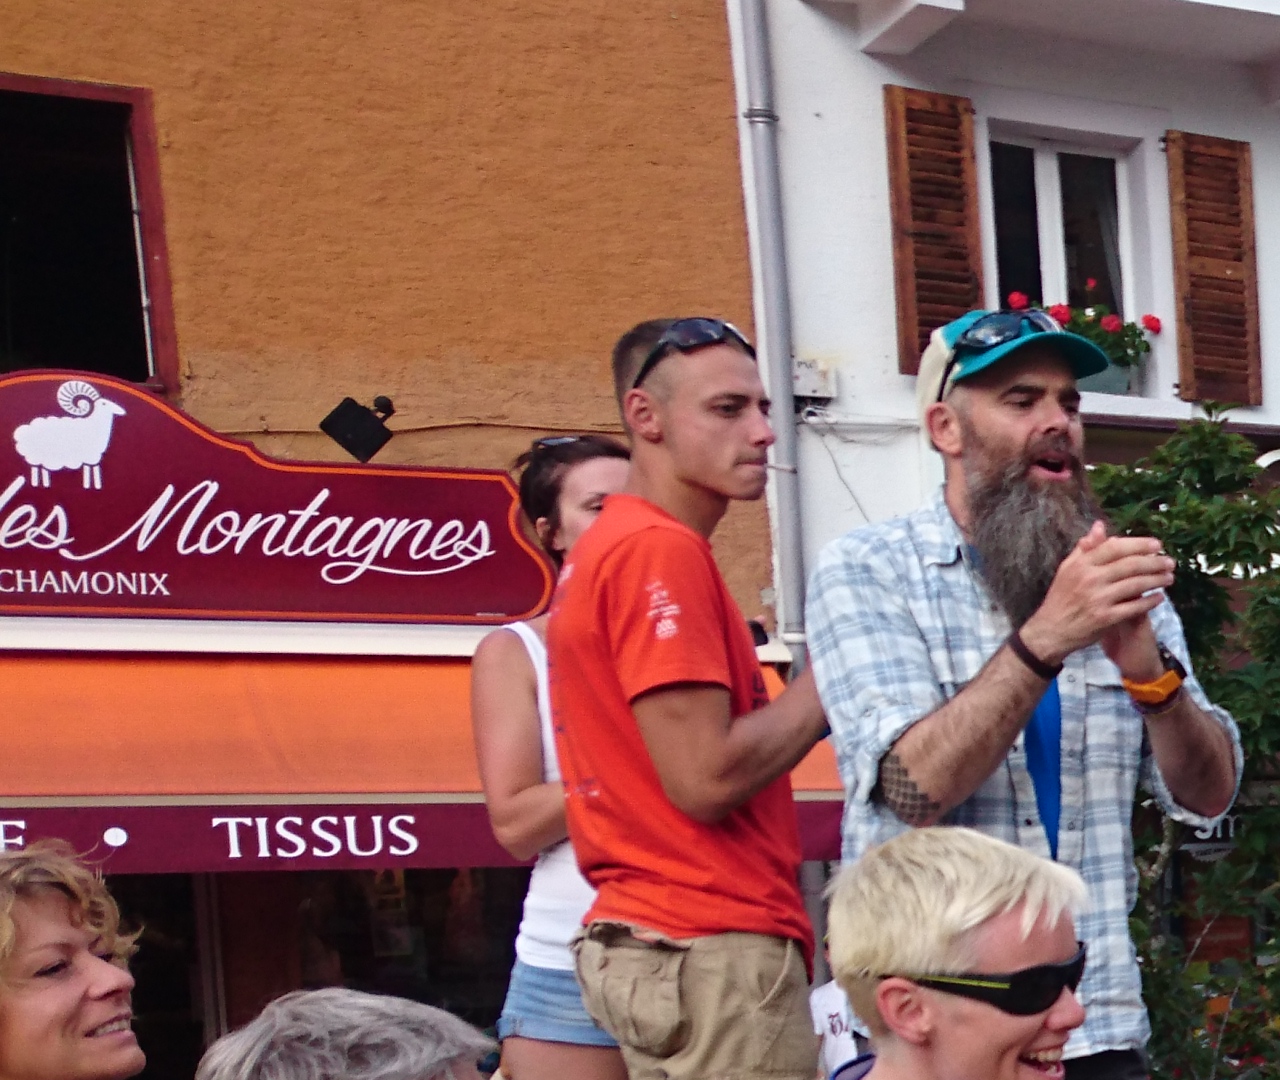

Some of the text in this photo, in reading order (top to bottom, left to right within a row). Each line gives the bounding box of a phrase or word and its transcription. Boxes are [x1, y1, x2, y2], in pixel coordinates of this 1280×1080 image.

[60, 480, 496, 584] Montagnes
[0, 568, 171, 596] CHAMONIX
[211, 815, 421, 860] TISSUS
